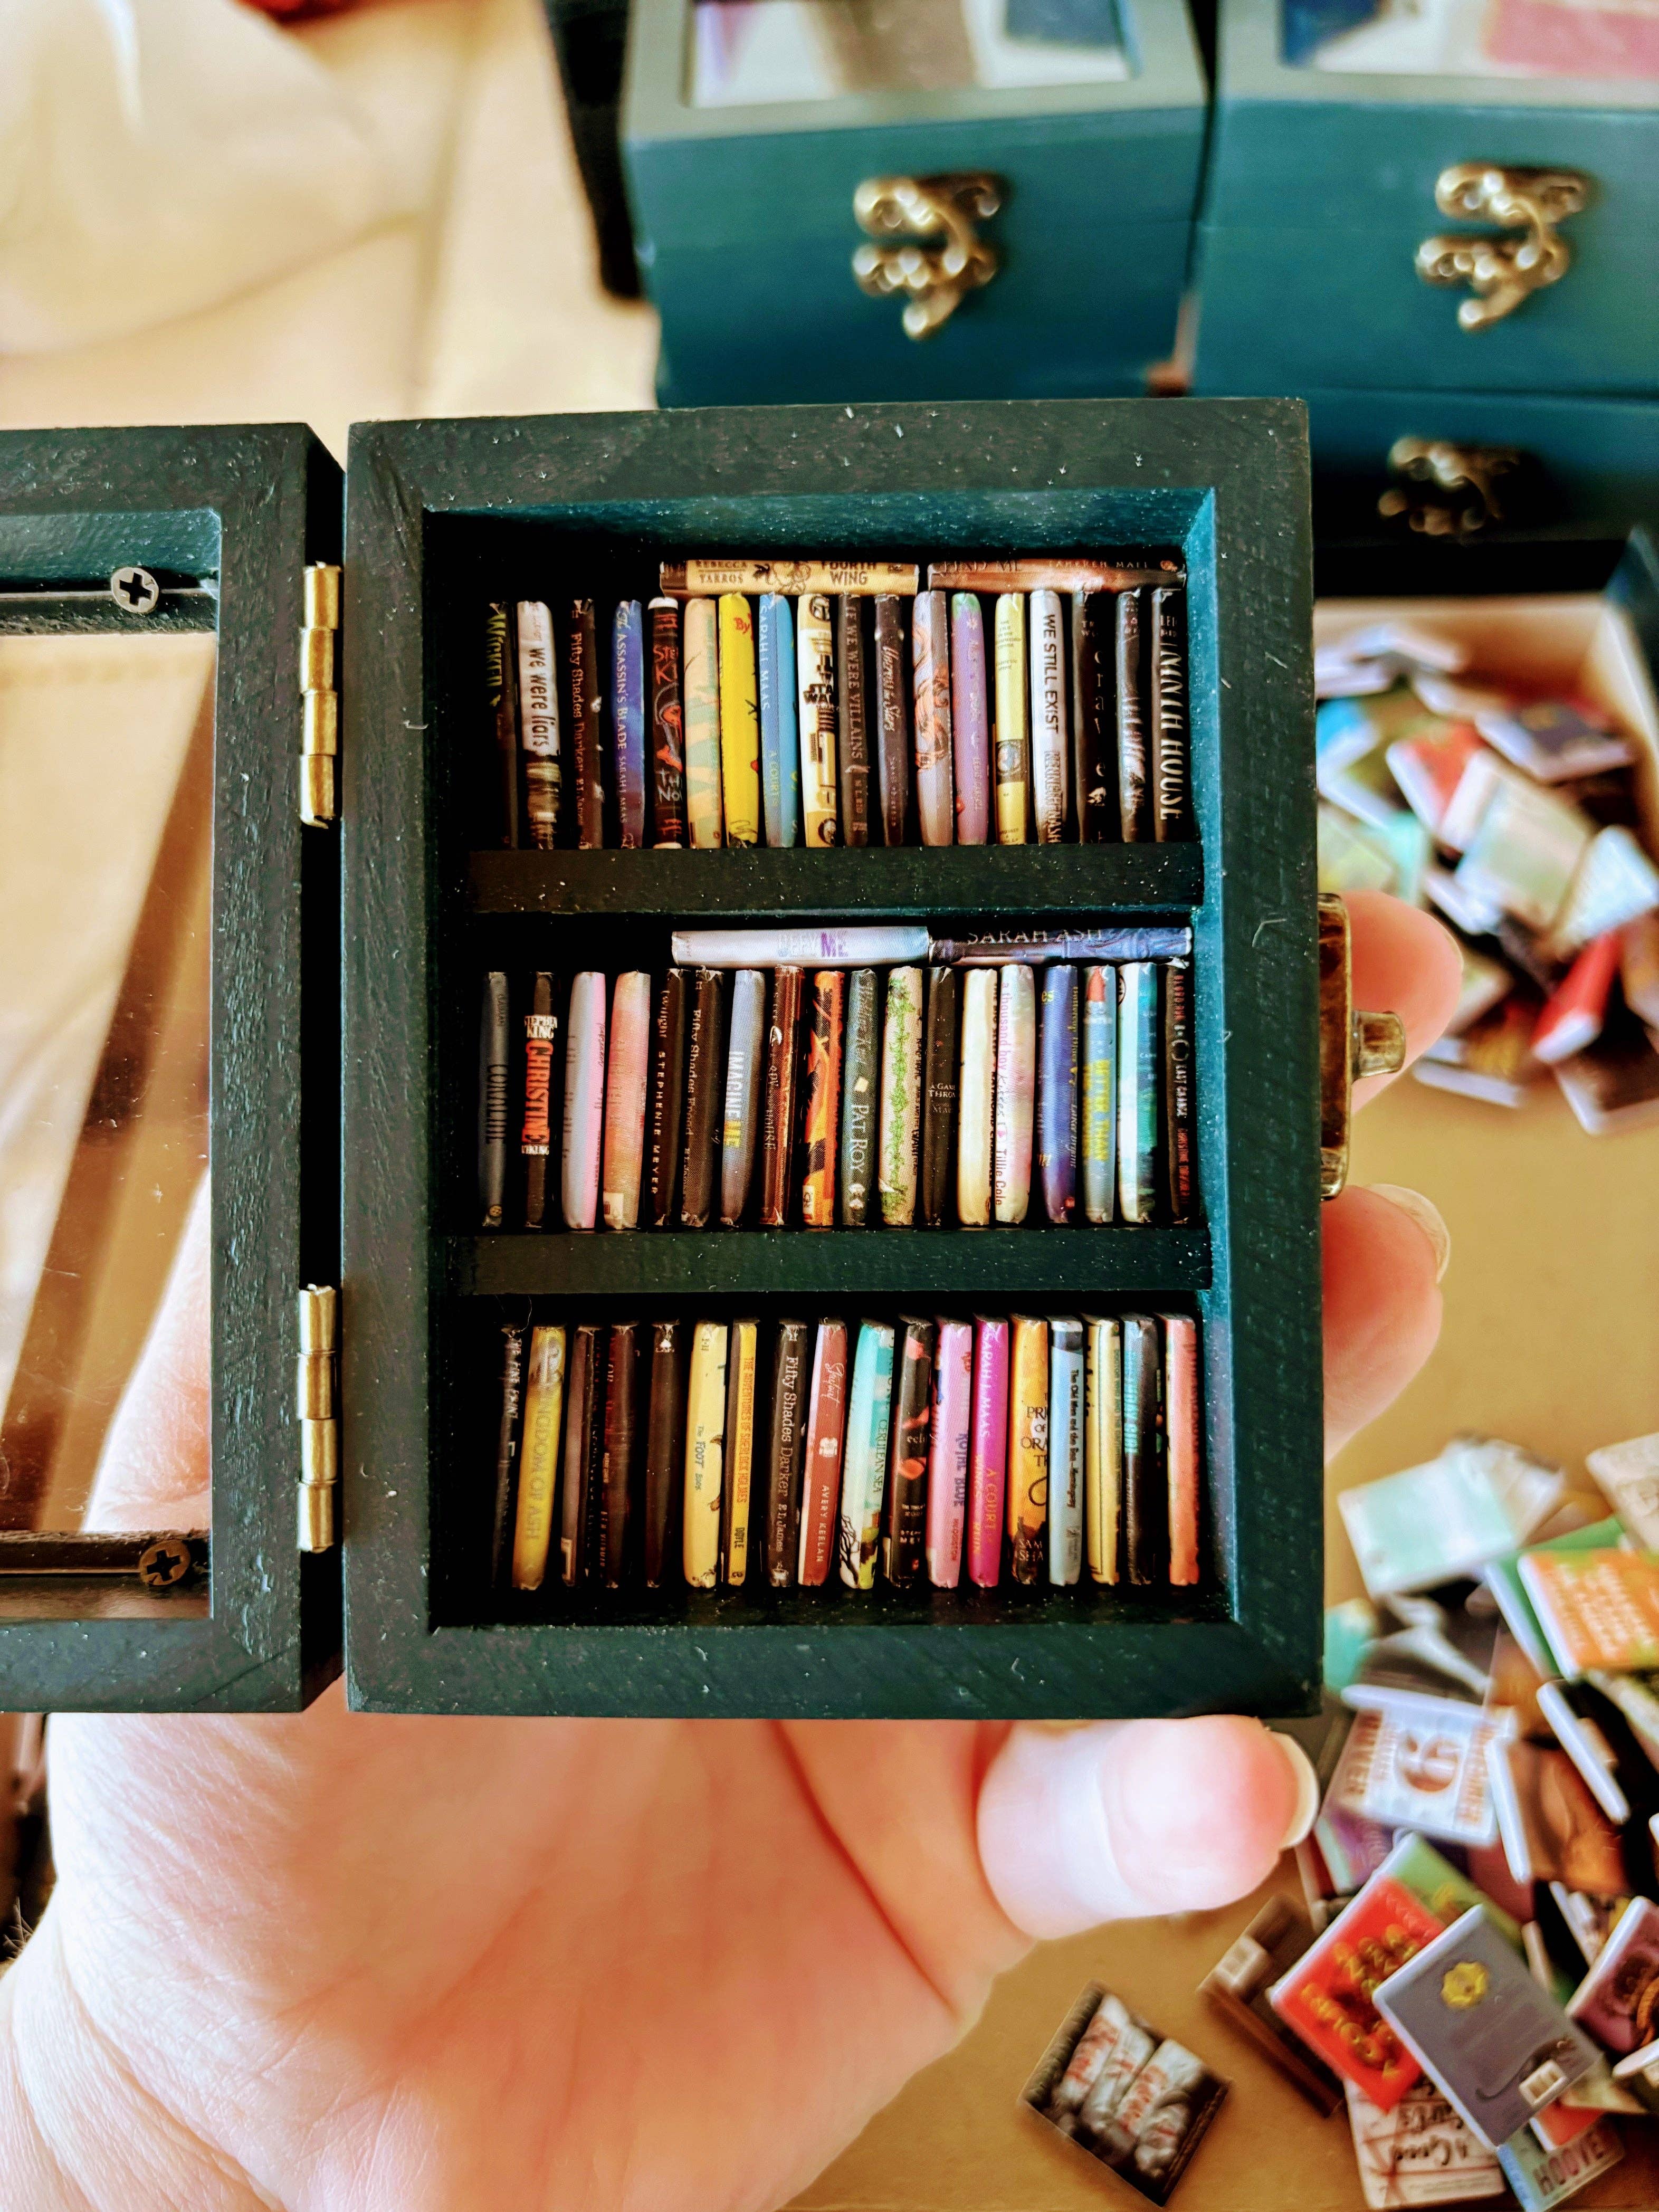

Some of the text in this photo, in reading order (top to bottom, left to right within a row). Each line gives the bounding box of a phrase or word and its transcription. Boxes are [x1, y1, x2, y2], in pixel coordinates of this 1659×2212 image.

[830, 570, 869, 586] WING
[570, 632, 583, 666] Fifty
[760, 605, 770, 653] SARAH
[1043, 614, 1056, 638] WE
[529, 647, 546, 668] we
[617, 634, 629, 703] ASSASSIN'S
[1044, 643, 1058, 685] STILL
[530, 673, 548, 710] were
[572, 669, 585, 718] Shades
[761, 670, 770, 711] MAAS
[845, 606, 863, 759] IF WE WERE VILLAINS
[532, 715, 557, 747] liars
[617, 708, 629, 750] BLADE
[1045, 690, 1059, 735] EXIST
[574, 721, 586, 772] Darker
[1160, 744, 1184, 821] HOUSE
[999, 994, 1013, 1046] thousand
[521, 1039, 554, 1144] CHRISTINE
[654, 1051, 666, 1136] STEPHENIE
[848, 1104, 870, 1174] PAT ROY
[651, 1145, 661, 1194] MEYER
[995, 1148, 1007, 1206] Tillie Cole
[782, 1356, 799, 1390] Fifty
[980, 1333, 994, 1379] SARAH
[781, 1392, 797, 1442] Shades
[979, 1398, 991, 1438] MAAS
[694, 1440, 706, 1469] FOOT
[778, 1447, 793, 1497] Darker
[873, 1419, 888, 1493] CERULEAN SEA
[816, 1485, 830, 1562] AVERY KEELAN
[986, 1483, 998, 1530] COURT
[776, 1520, 786, 1553] James
